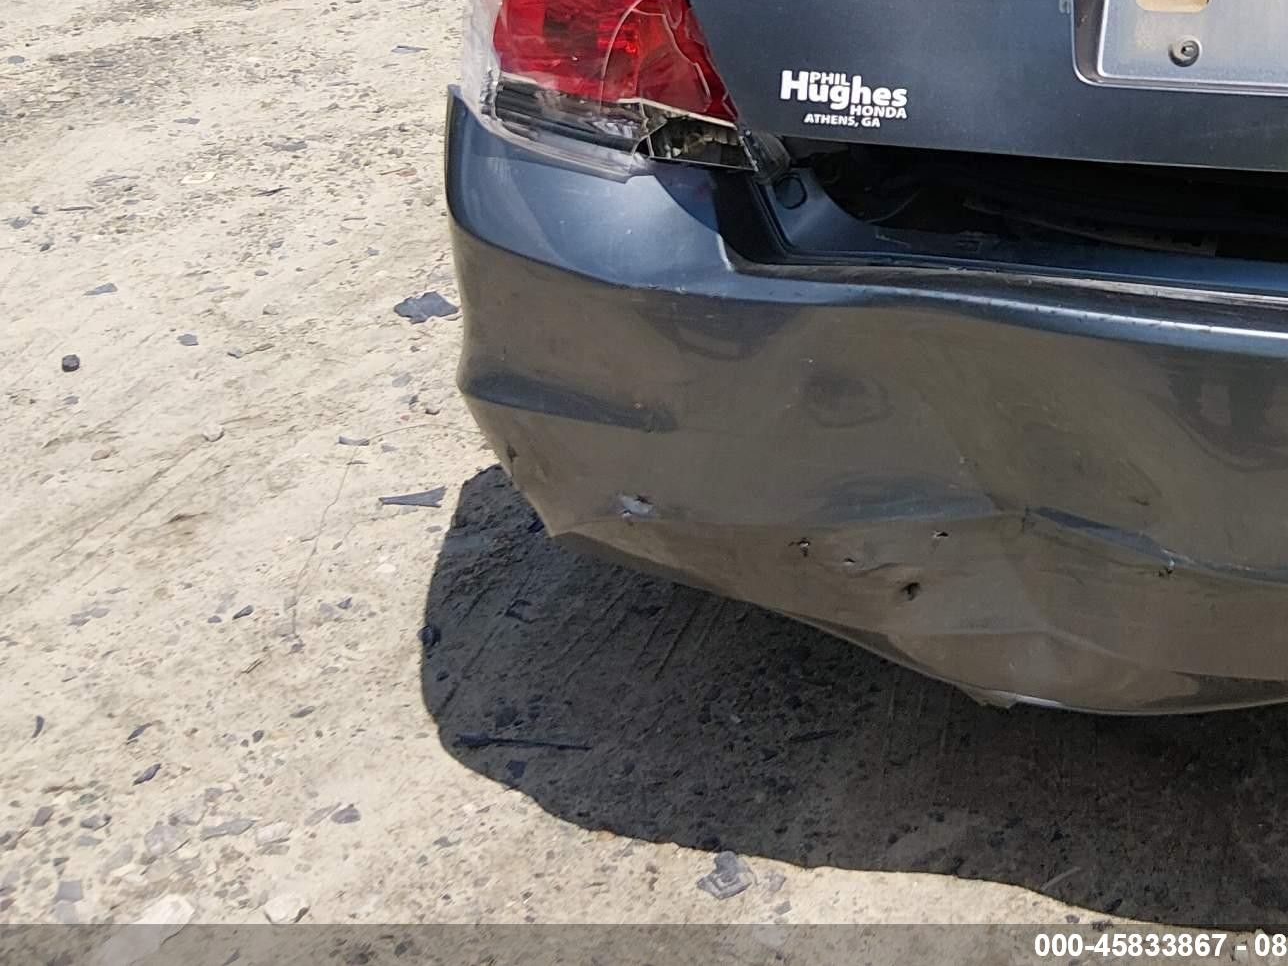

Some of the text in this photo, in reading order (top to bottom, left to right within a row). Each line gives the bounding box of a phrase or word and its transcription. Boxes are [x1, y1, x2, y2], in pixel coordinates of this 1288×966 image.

[809, 71, 851, 86] PHIL
[780, 69, 908, 110] Hughes
[849, 104, 908, 119] HONDA
[803, 113, 881, 128] ATHENS, GA
